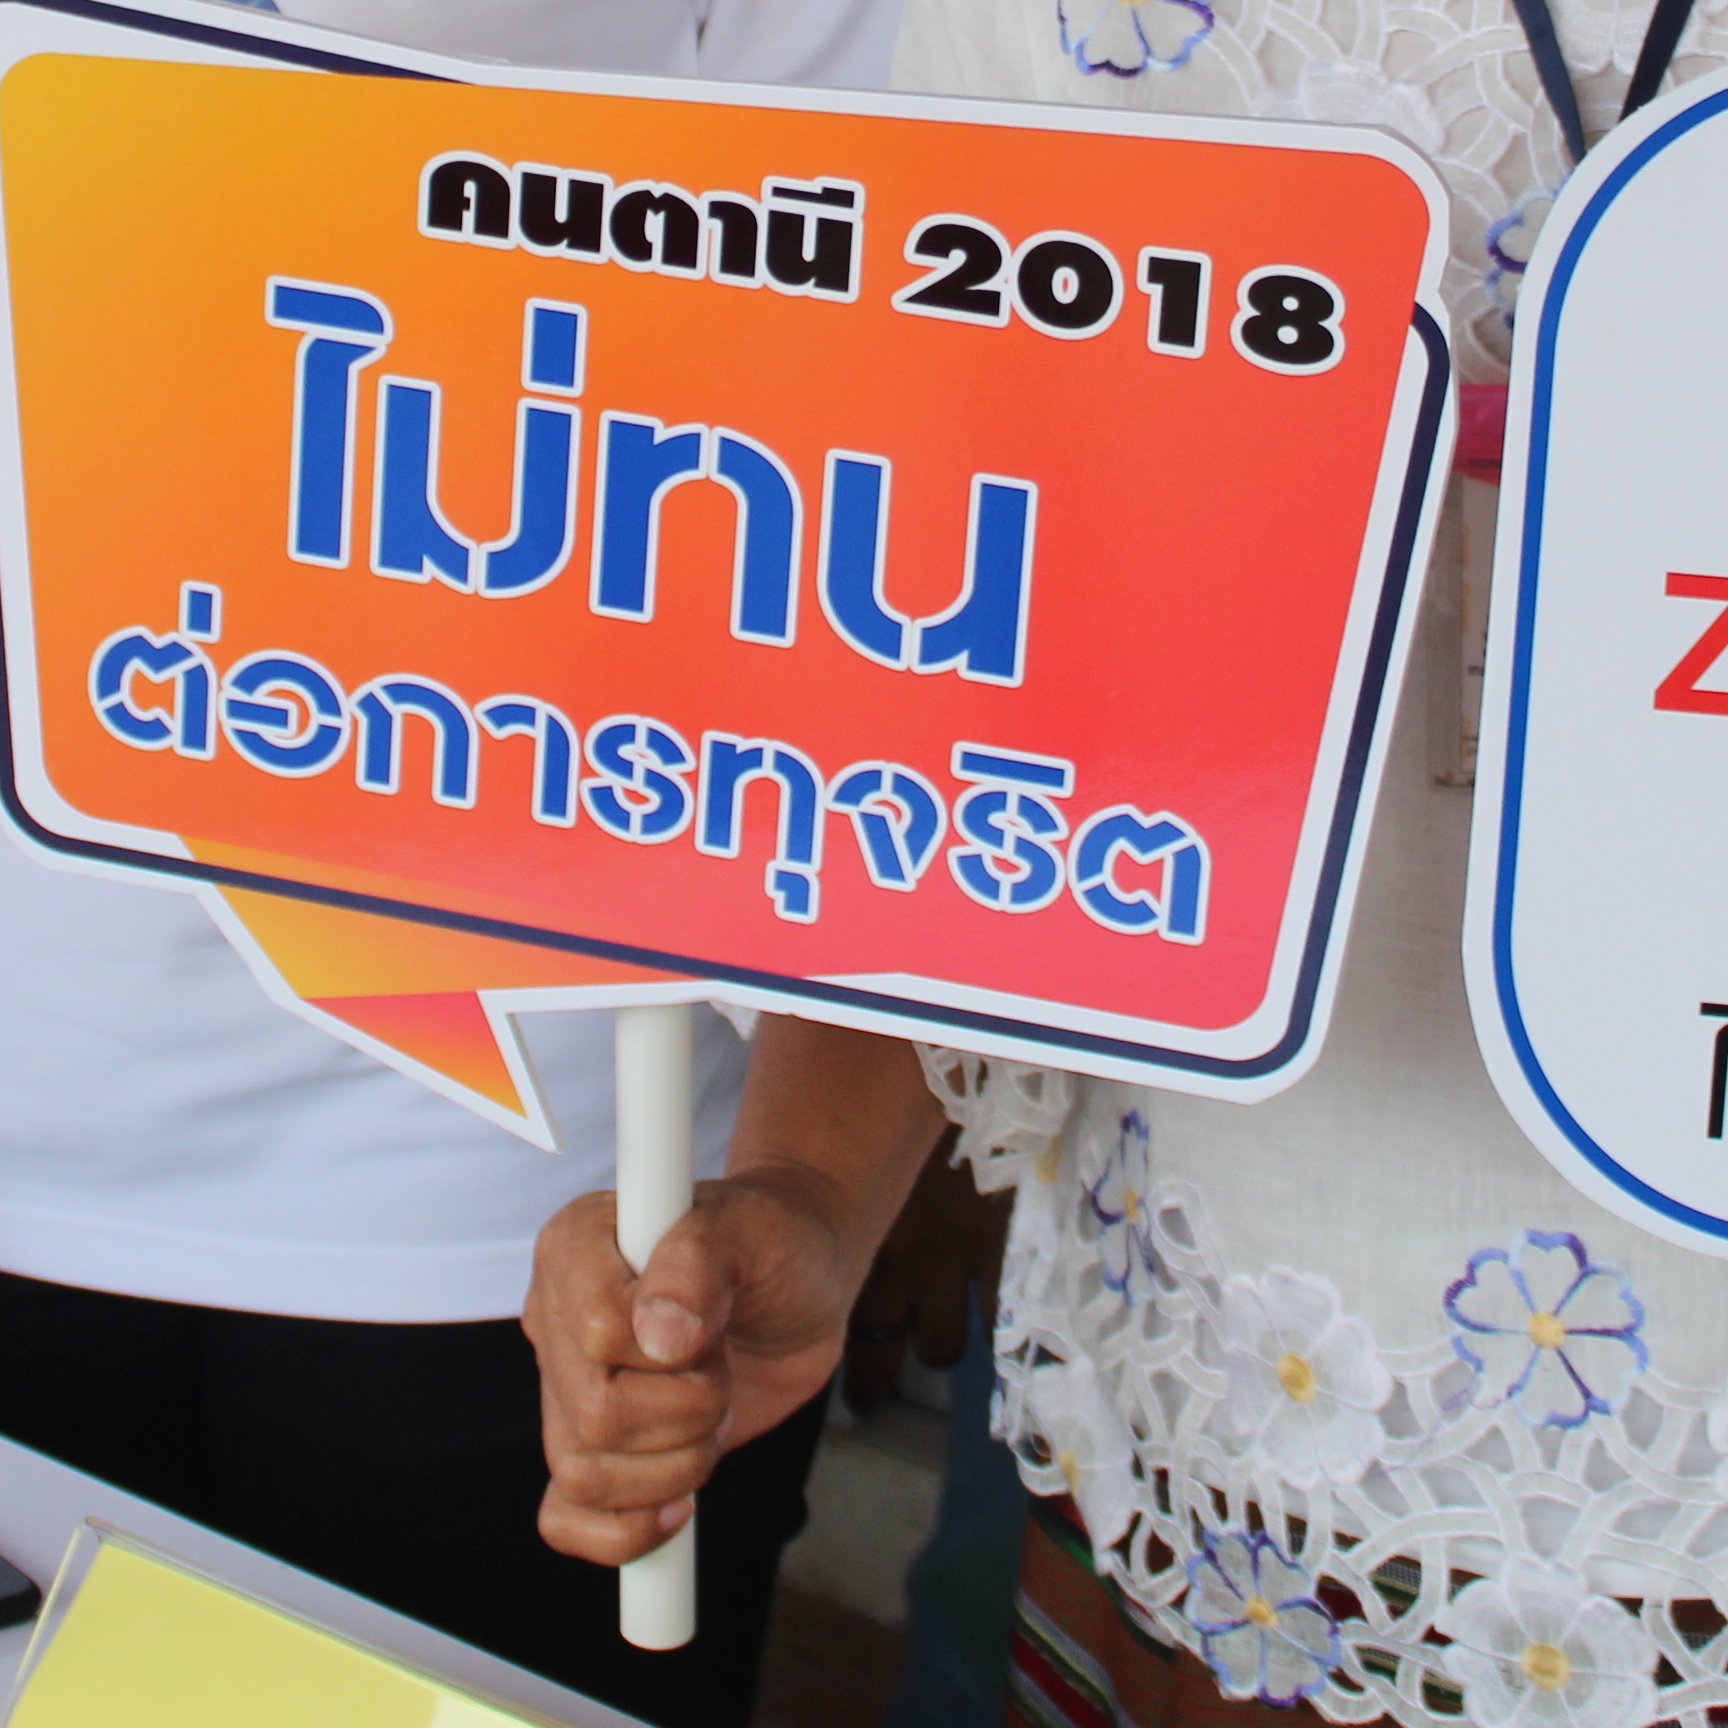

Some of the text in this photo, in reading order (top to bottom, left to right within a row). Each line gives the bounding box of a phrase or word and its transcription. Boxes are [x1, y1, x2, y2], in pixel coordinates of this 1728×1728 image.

[426, 158, 1338, 368] คนตานี 2018
[270, 282, 1034, 682] ไม่ทน
[93, 588, 1206, 939] ต่อการทุจริต
